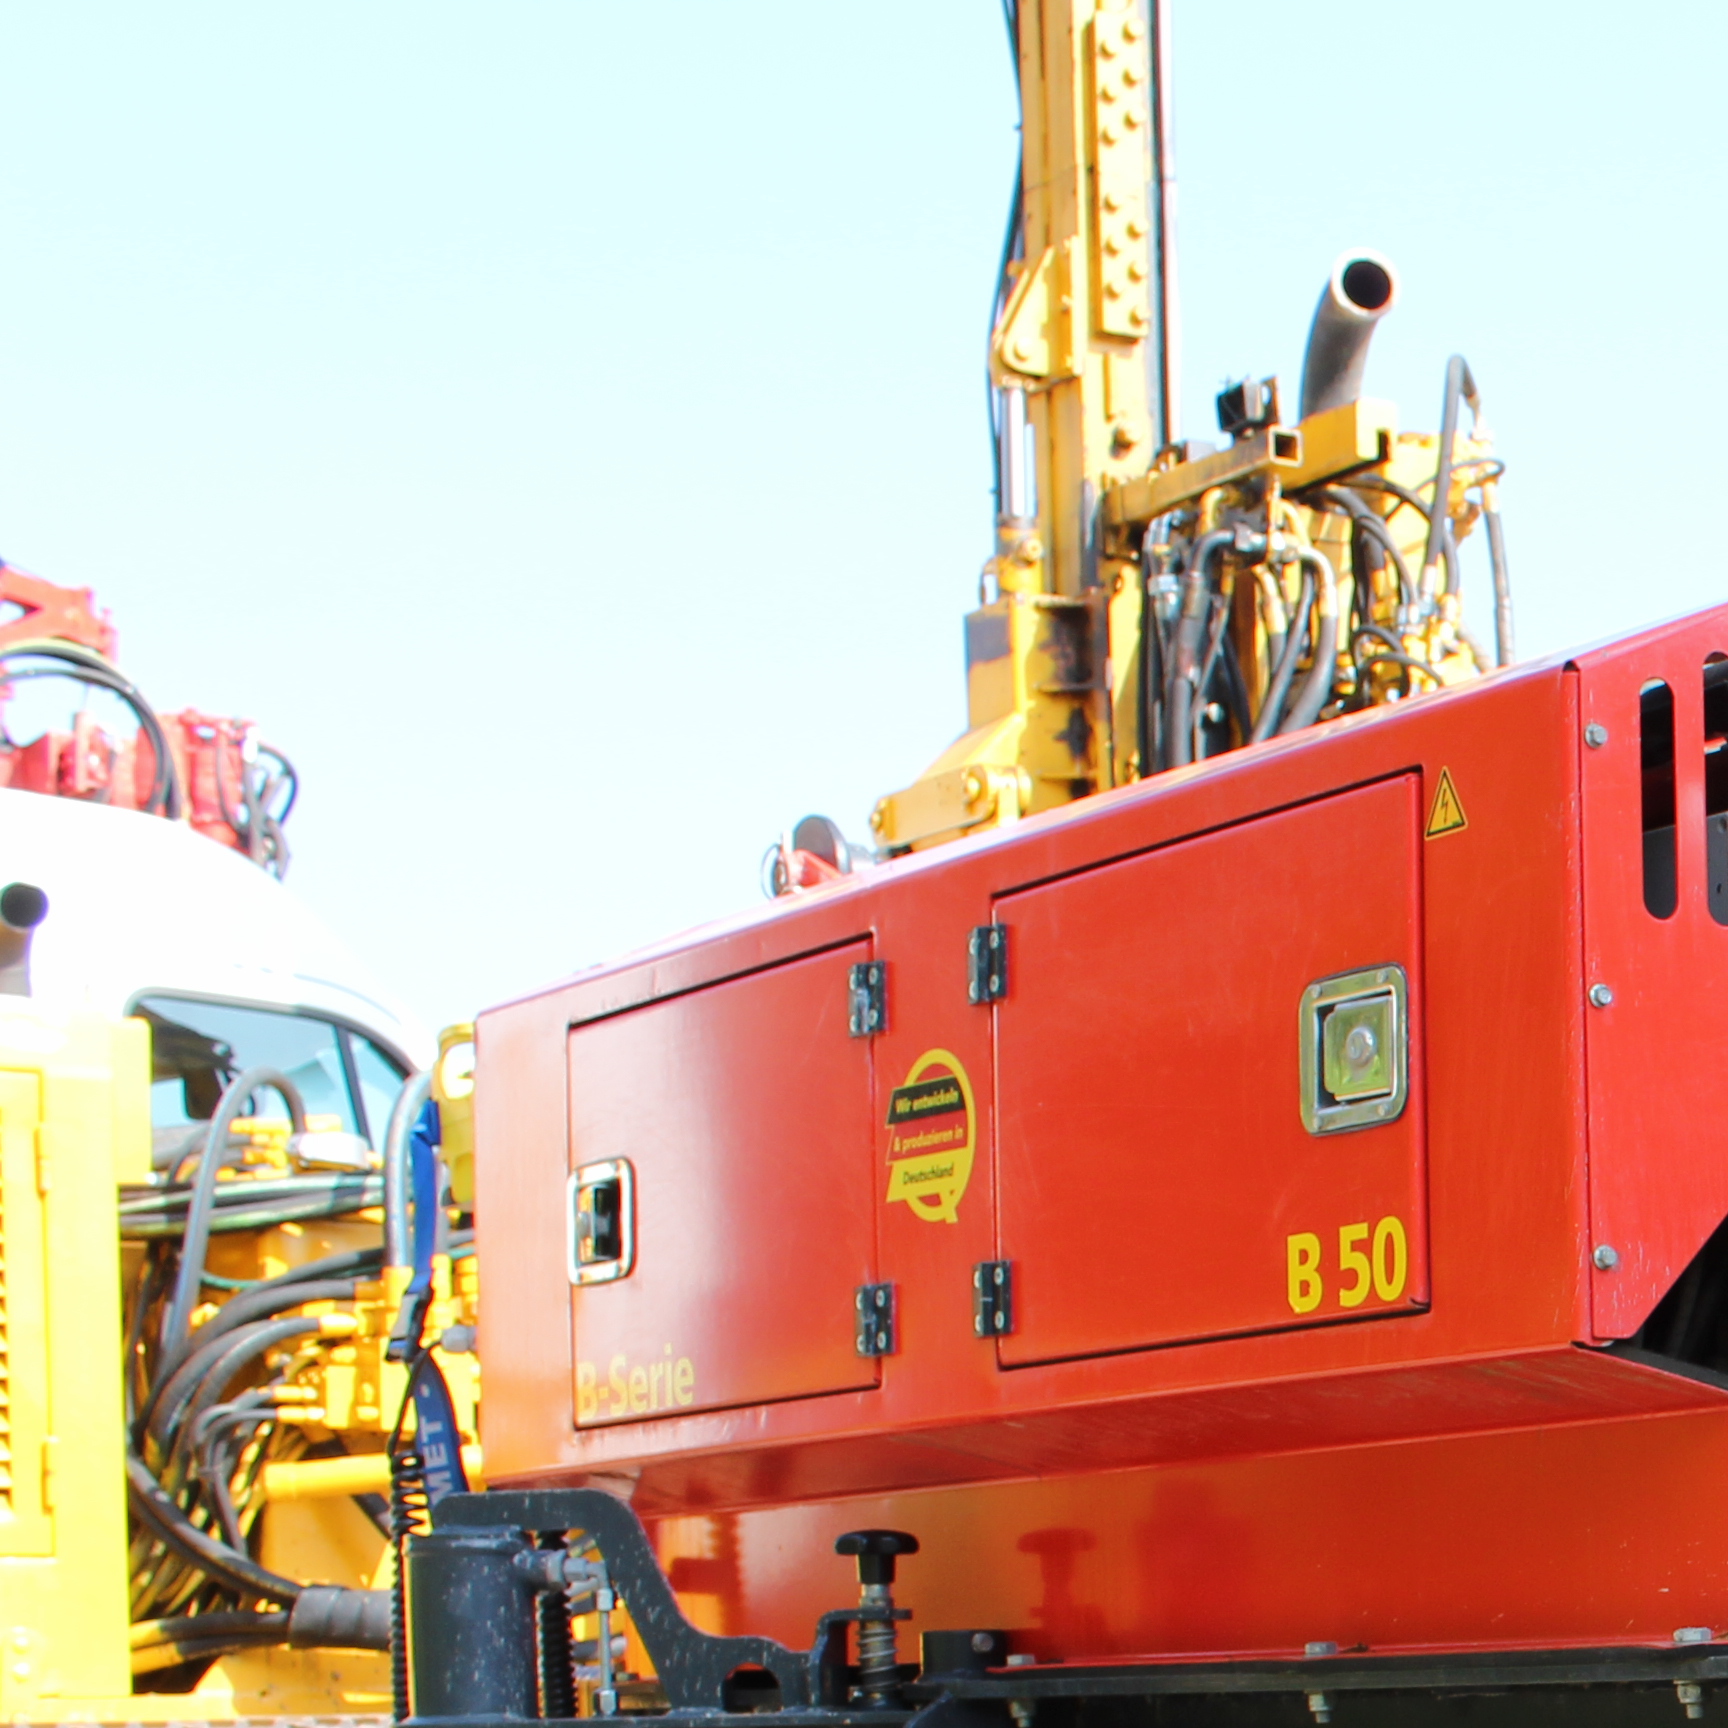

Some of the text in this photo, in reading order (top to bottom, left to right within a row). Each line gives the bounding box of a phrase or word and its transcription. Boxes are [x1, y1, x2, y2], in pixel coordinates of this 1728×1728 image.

[954, 1124, 964, 1140] in
[903, 1161, 955, 1185] Deutschland
[1287, 1215, 1408, 1314] B 50
[577, 1342, 695, 1421] B-Serie
